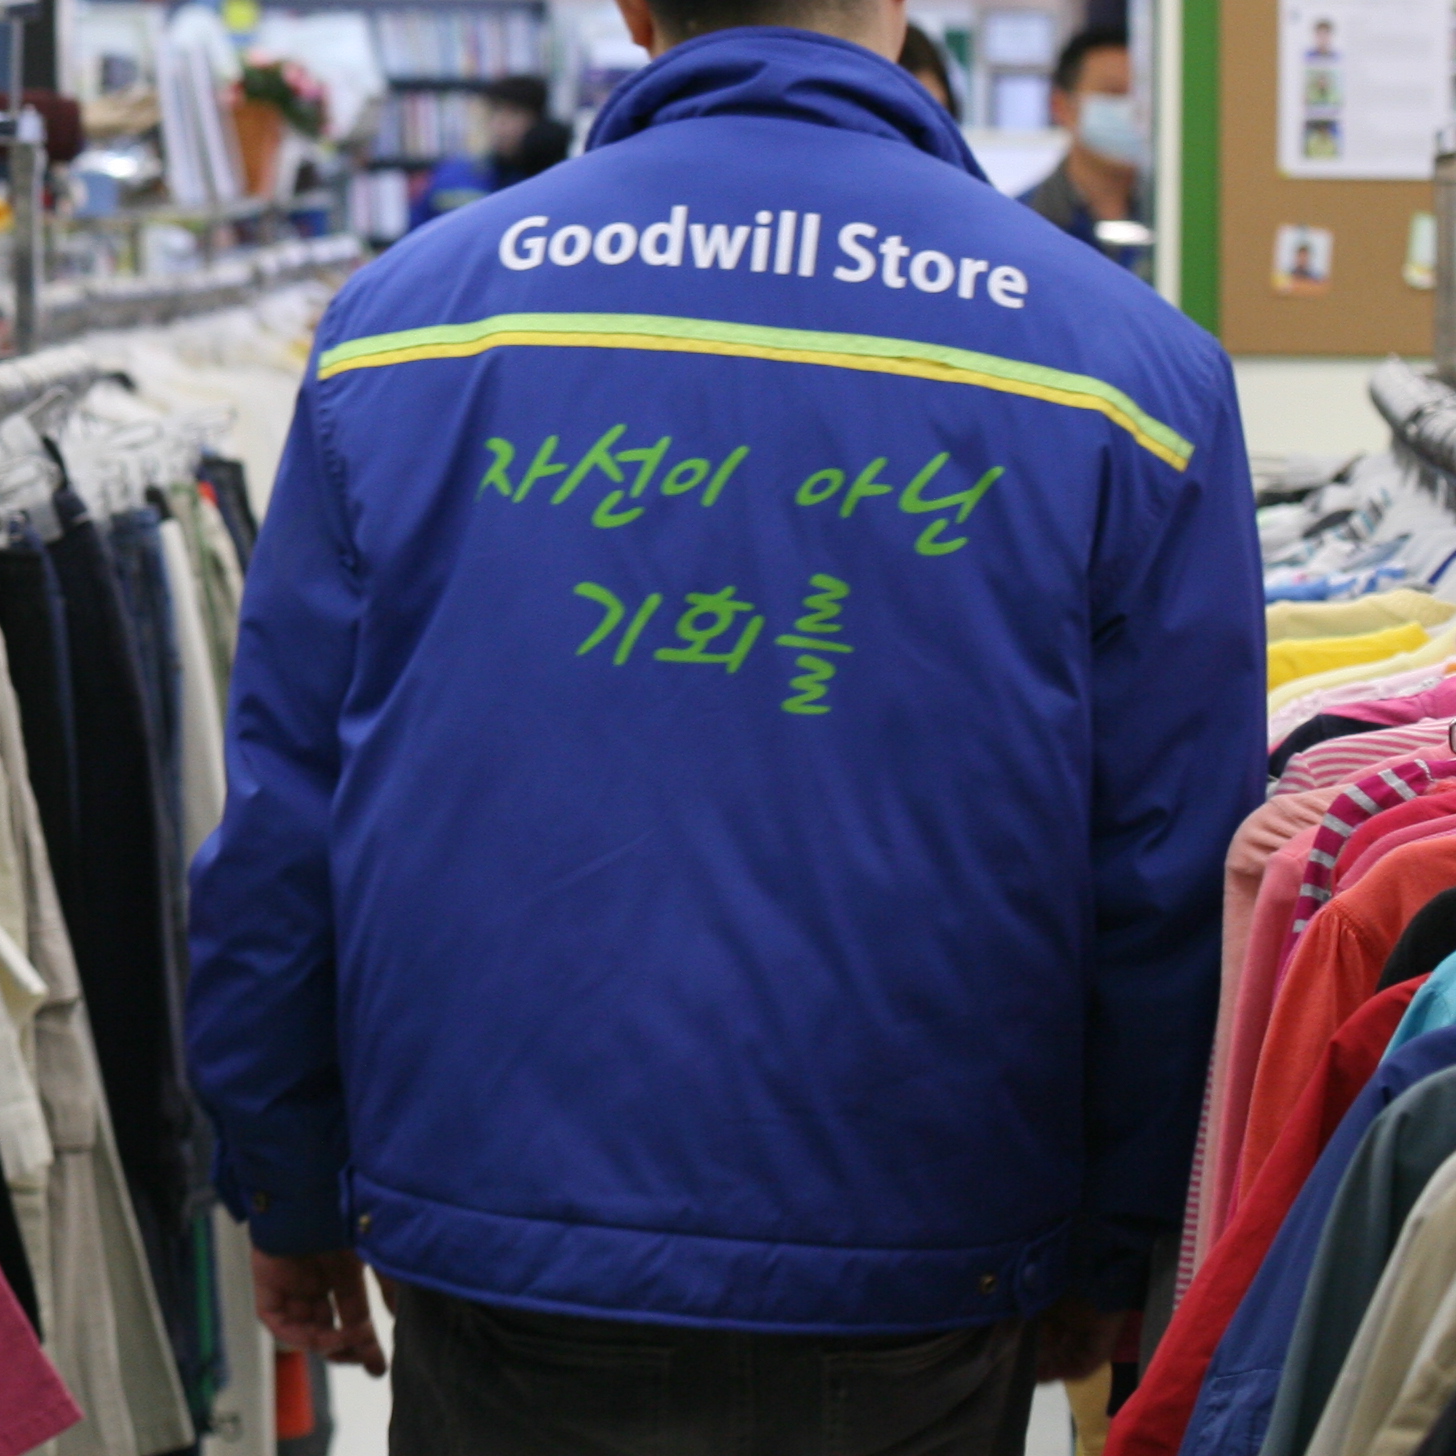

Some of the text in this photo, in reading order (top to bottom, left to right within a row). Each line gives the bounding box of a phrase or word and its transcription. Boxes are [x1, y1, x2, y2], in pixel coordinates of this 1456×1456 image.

[498, 204, 1030, 310] Goodwill Store
[475, 423, 1005, 556] 자선이 아닌
[573, 573, 854, 715] 기회를
